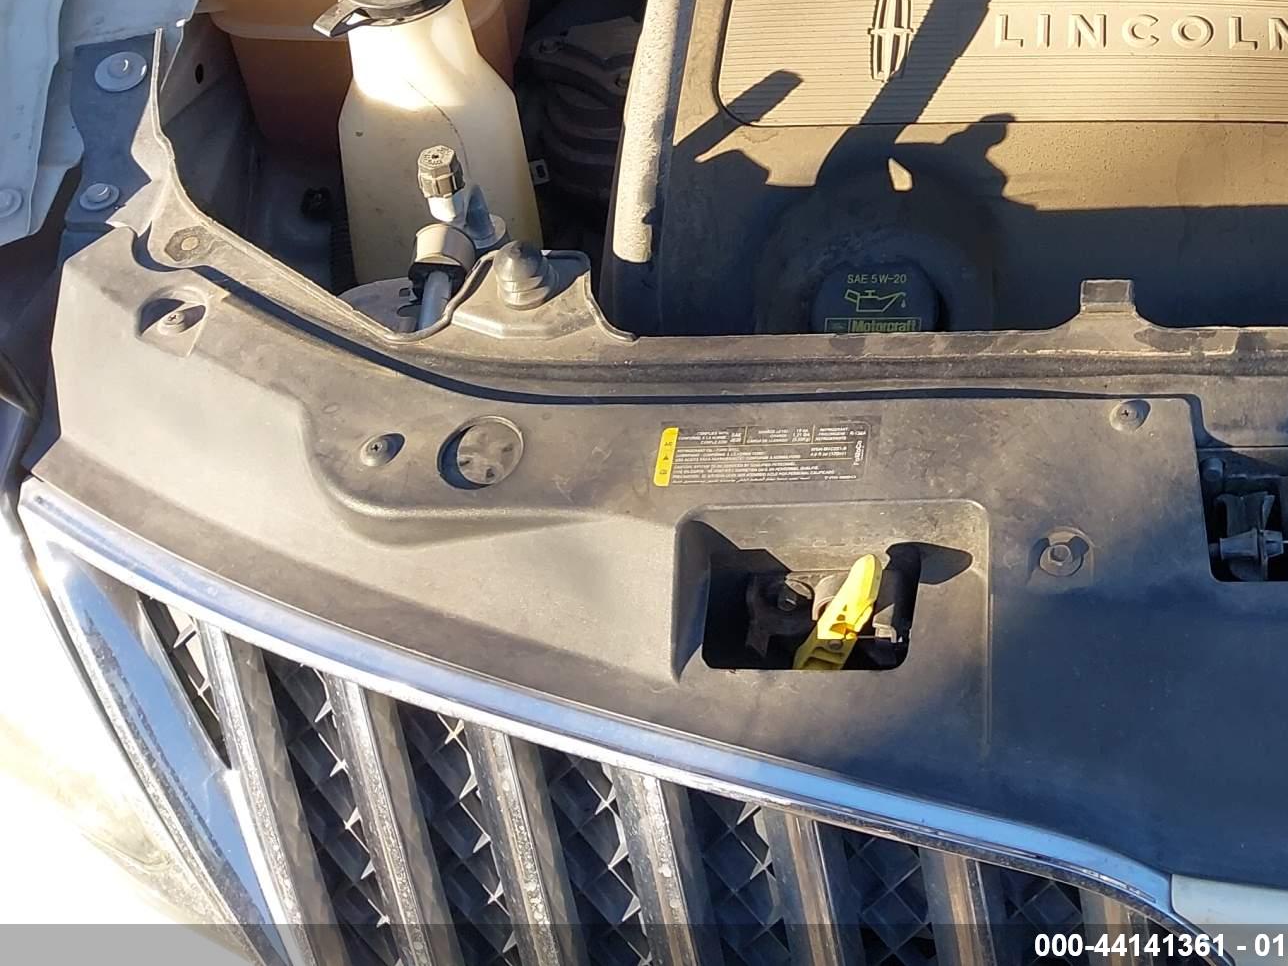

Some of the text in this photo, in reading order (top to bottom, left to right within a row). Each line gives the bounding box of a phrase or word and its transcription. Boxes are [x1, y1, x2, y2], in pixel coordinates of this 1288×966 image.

[847, 273, 907, 284] SAE 5W-20
[851, 319, 917, 333] Motorcraft
